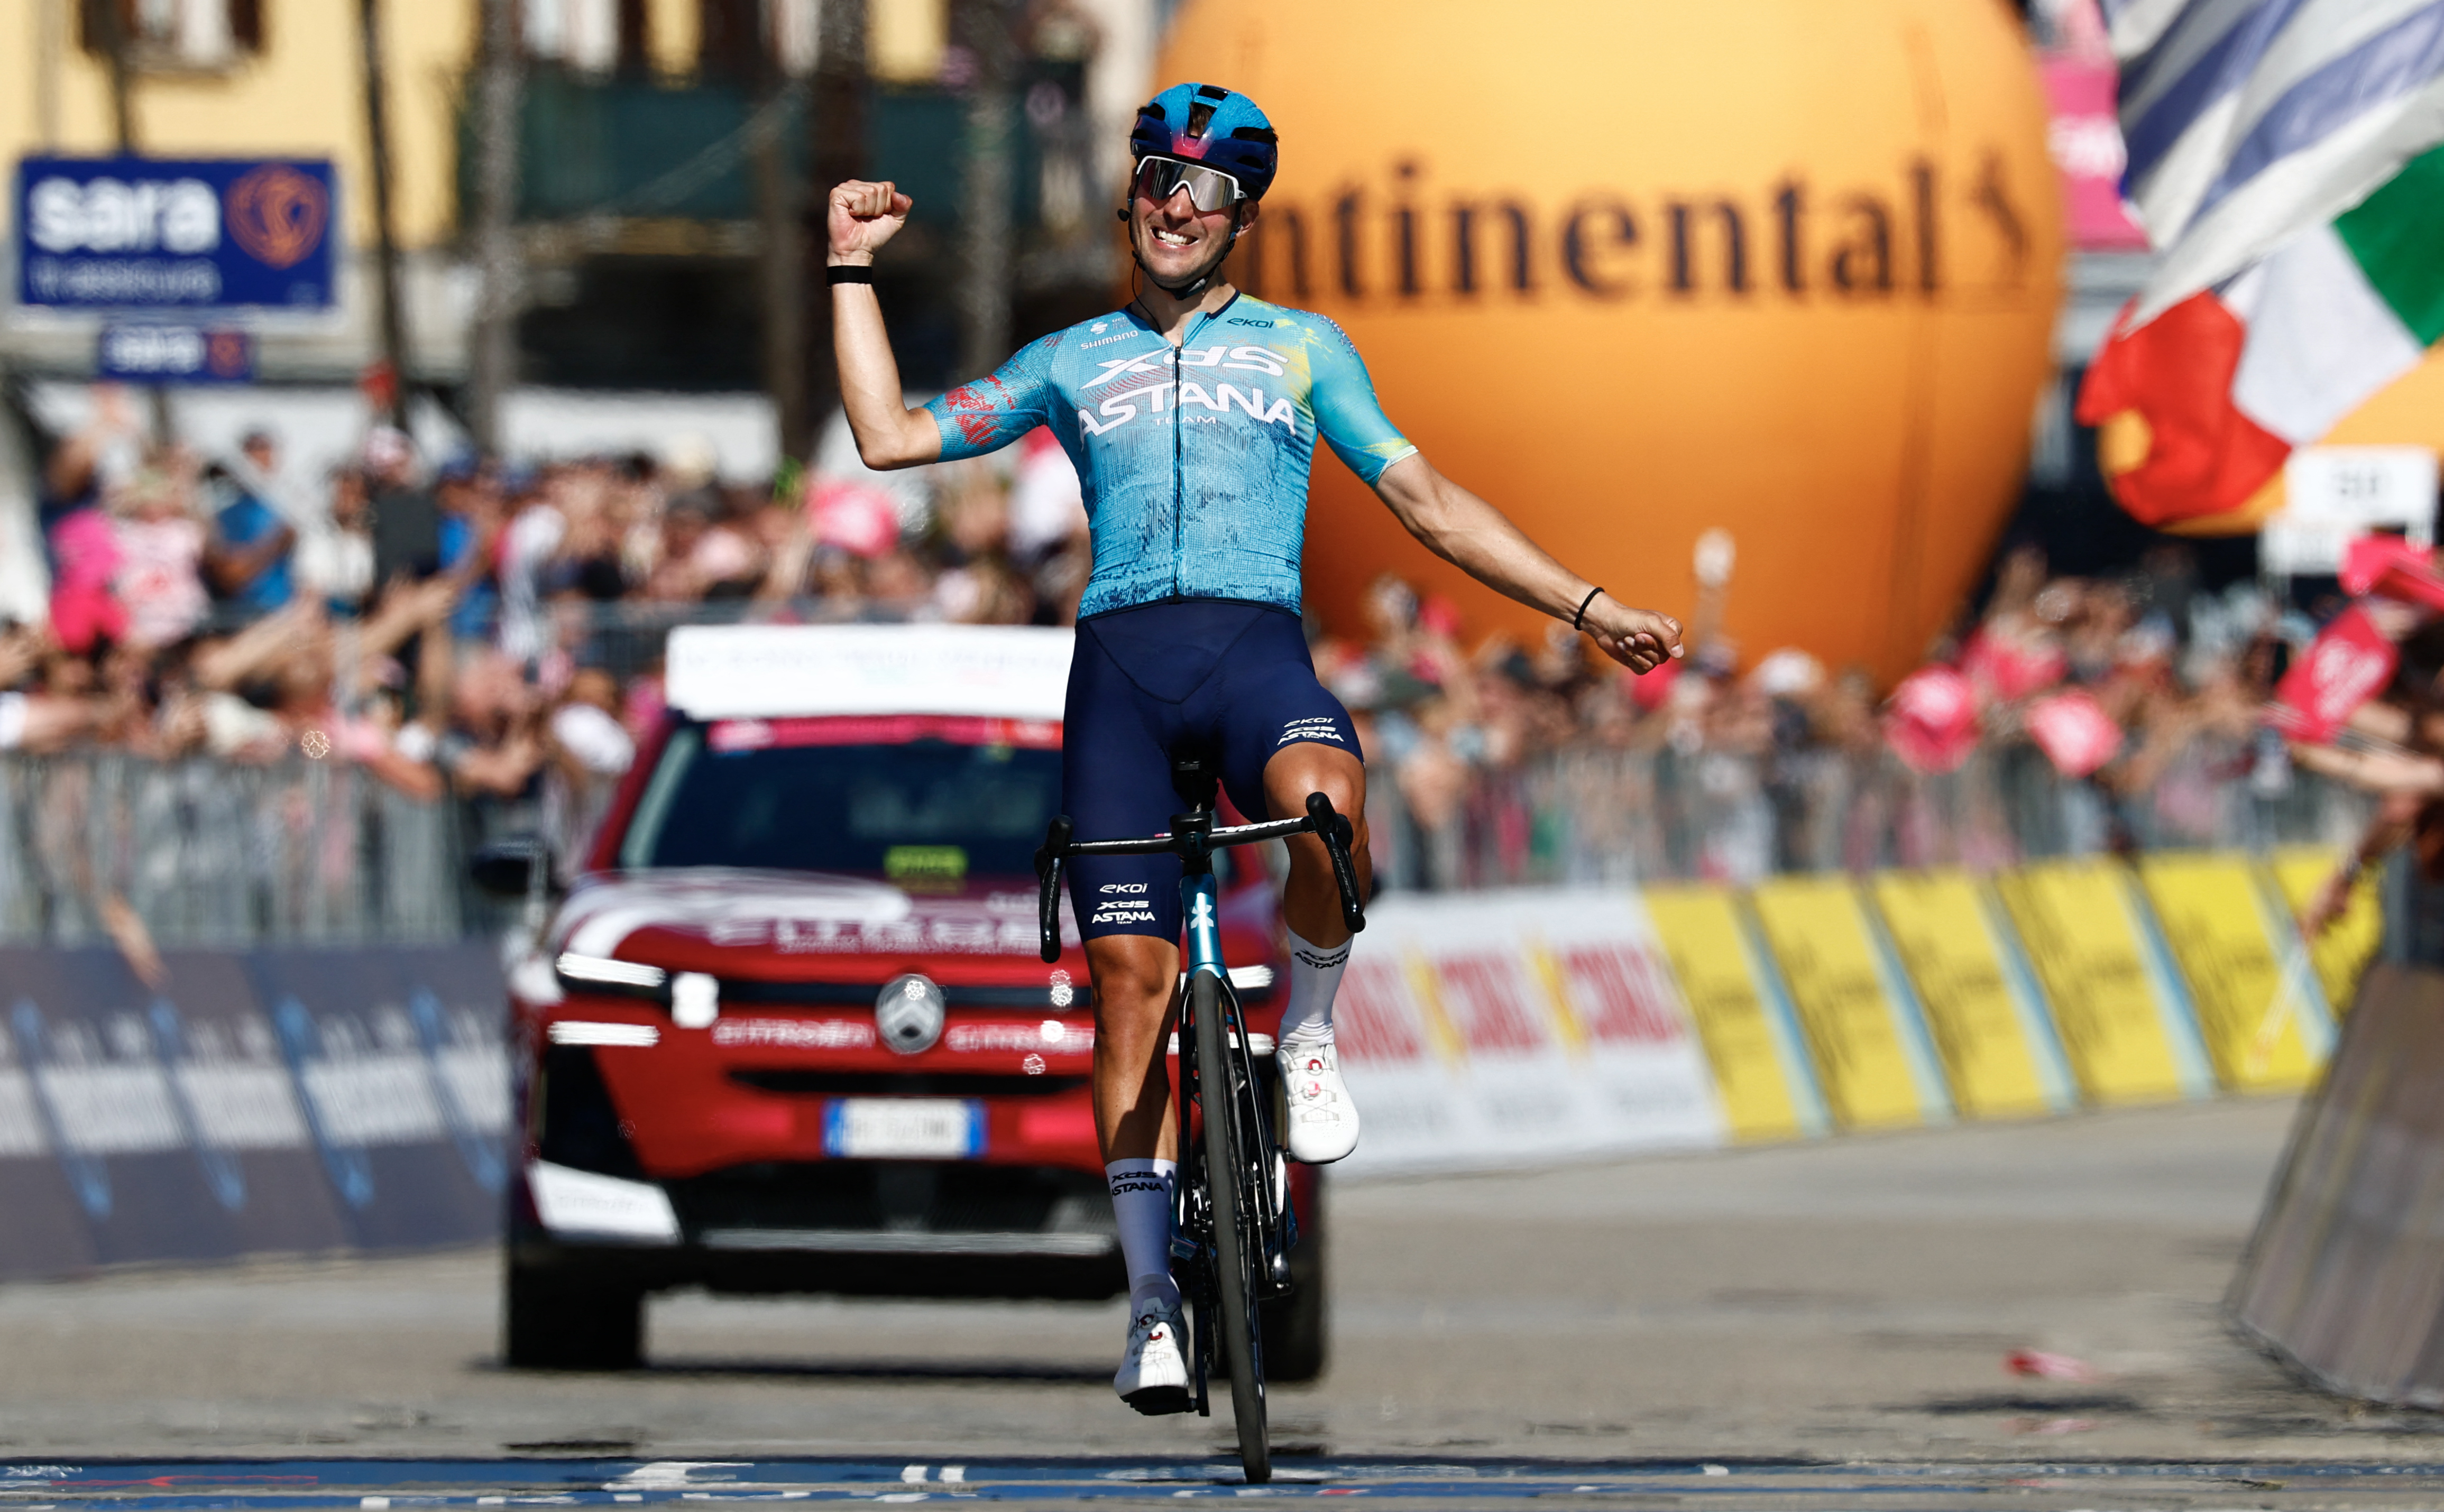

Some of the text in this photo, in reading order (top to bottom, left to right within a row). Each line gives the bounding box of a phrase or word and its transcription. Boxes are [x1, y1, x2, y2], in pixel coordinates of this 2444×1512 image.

[30, 177, 220, 253] sara
[1240, 154, 1940, 302] ntinental
[1081, 330, 1138, 350] SHIMANO
[1078, 380, 1296, 452] ASTANA
[1152, 415, 1216, 426] TEAM
[1277, 731, 1344, 745] ASTANA
[1092, 911, 1156, 924] ASTANA
